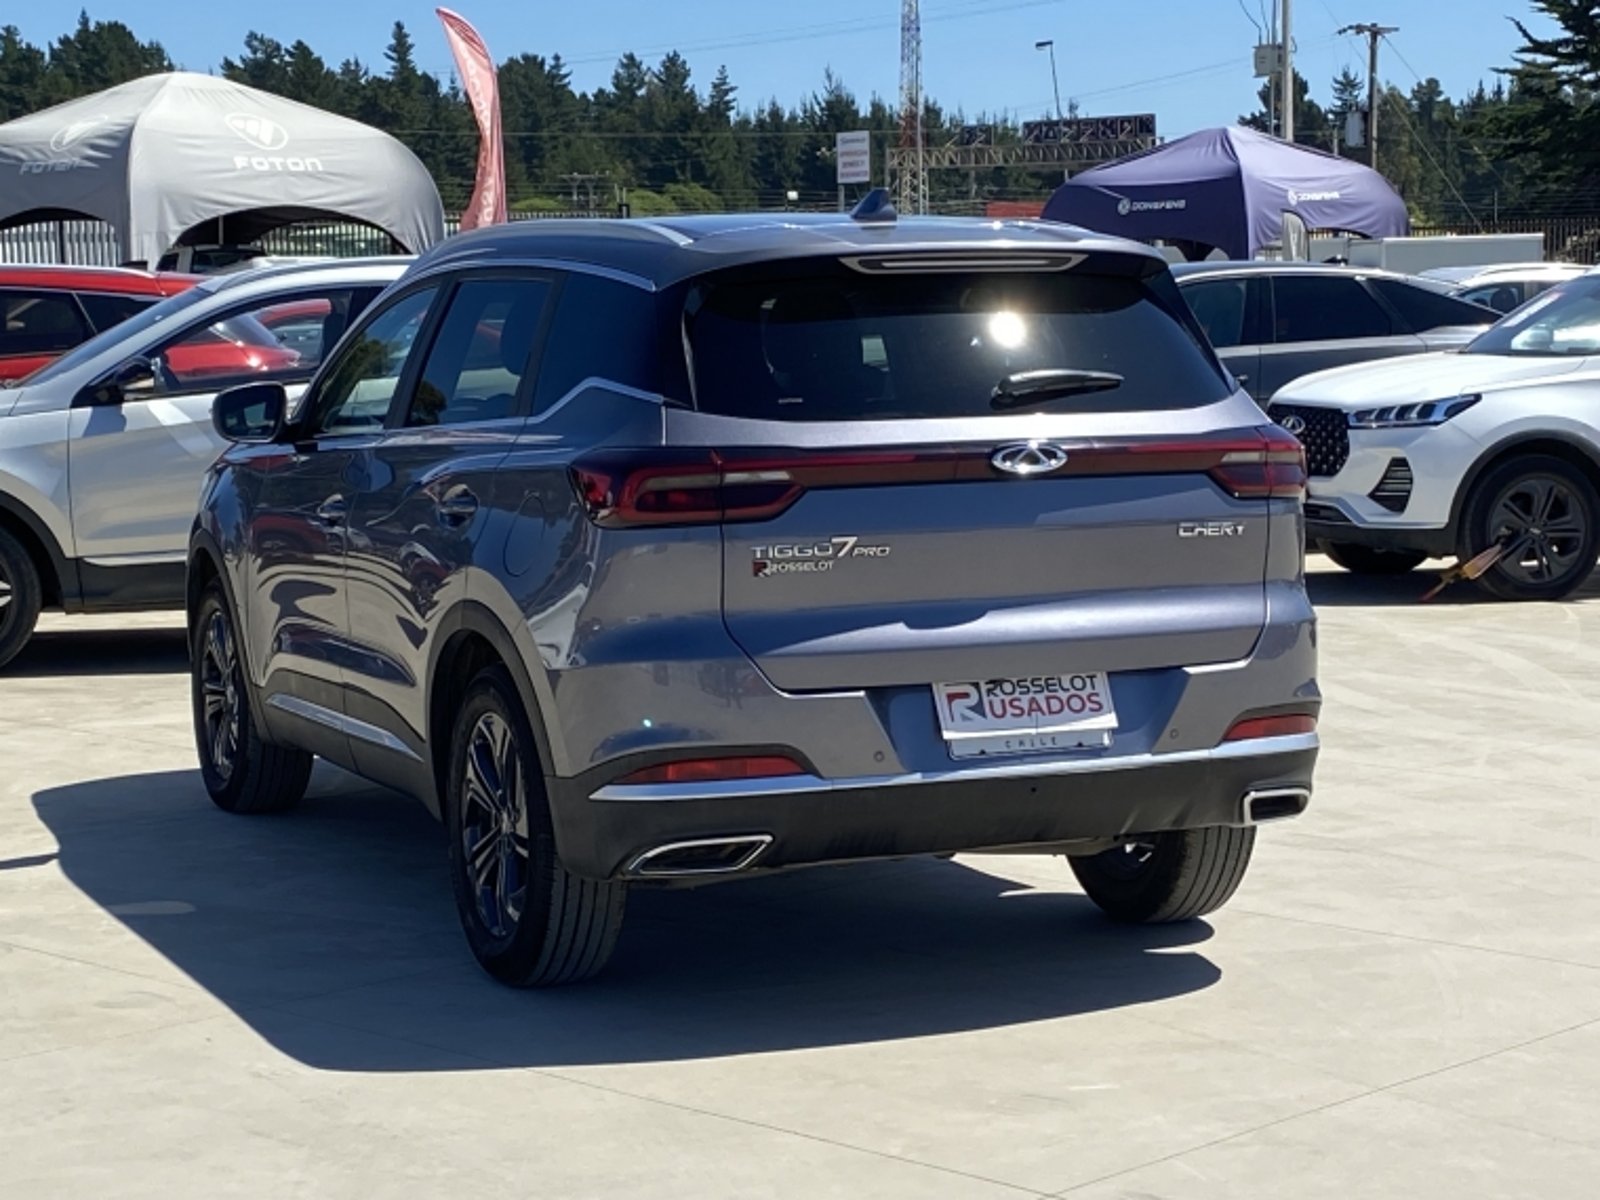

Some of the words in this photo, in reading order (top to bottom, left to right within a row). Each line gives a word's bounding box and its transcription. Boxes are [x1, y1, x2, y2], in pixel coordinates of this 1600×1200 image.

[232, 154, 324, 172] FOTON
[984, 674, 1098, 698] ROSSELOT
[988, 692, 1104, 719] USADOS
[1004, 736, 1059, 750] CHILE
